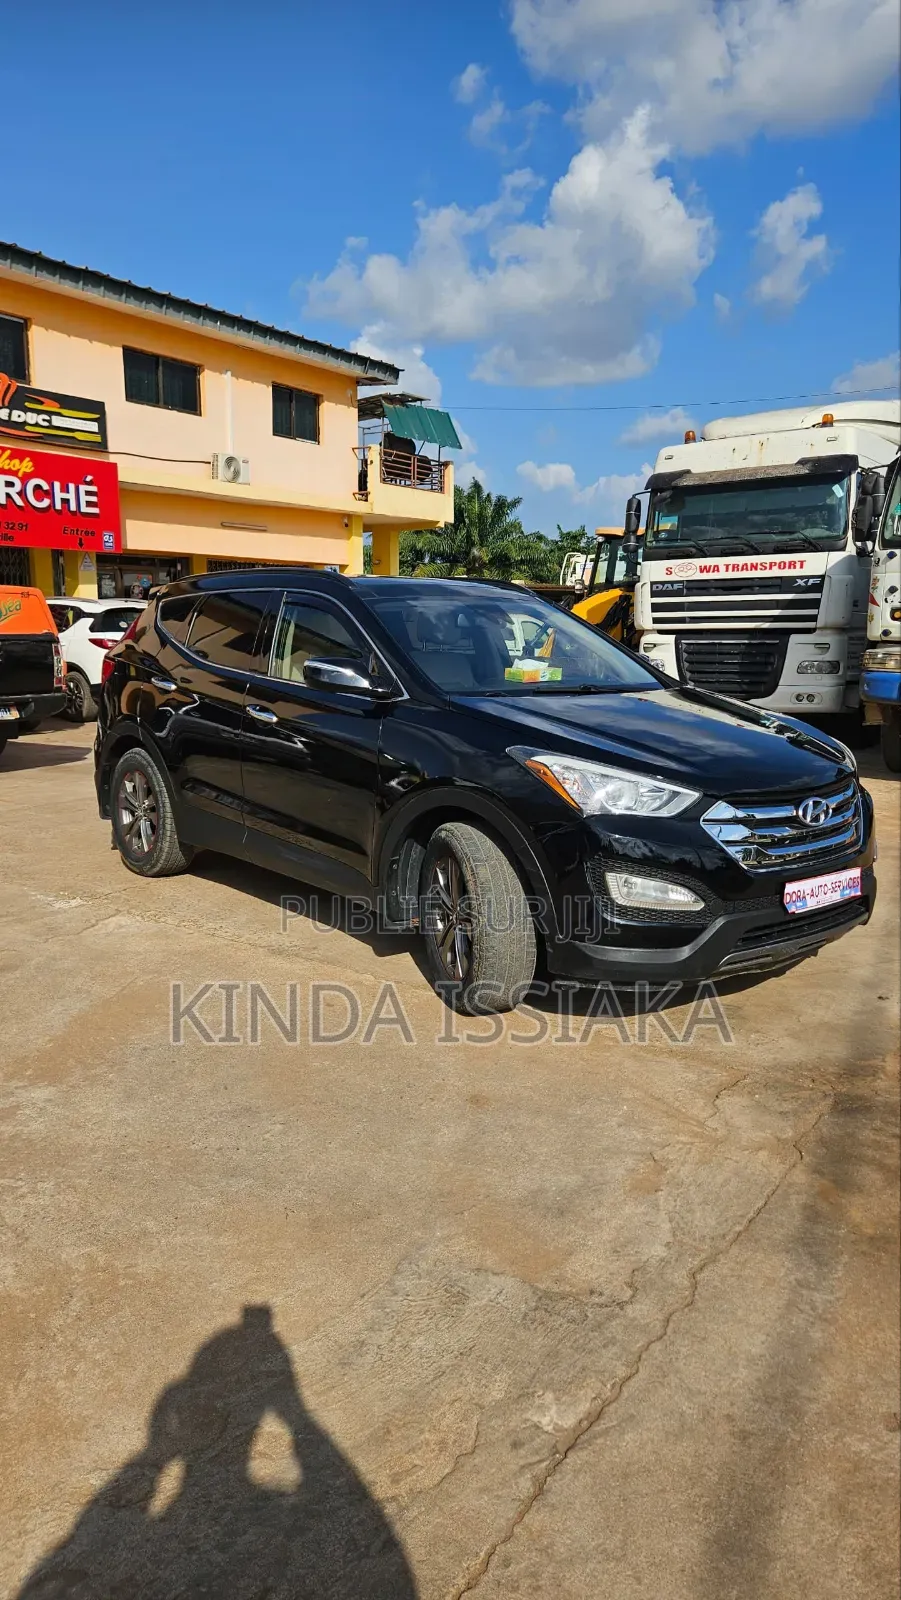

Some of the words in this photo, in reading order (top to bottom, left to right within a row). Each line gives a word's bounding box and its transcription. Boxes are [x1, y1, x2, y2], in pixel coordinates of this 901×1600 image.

[11, 410, 50, 426] DUC
[0, 450, 35, 477] hop
[4, 521, 15, 530] 32
[17, 522, 28, 531] 91
[62, 526, 96, 537] Entrée
[724, 560, 807, 573] TRANSPORT
[652, 583, 684, 591] DAF
[792, 578, 822, 586] XF
[785, 876, 860, 905] DORA-AUTO-SERVICES
